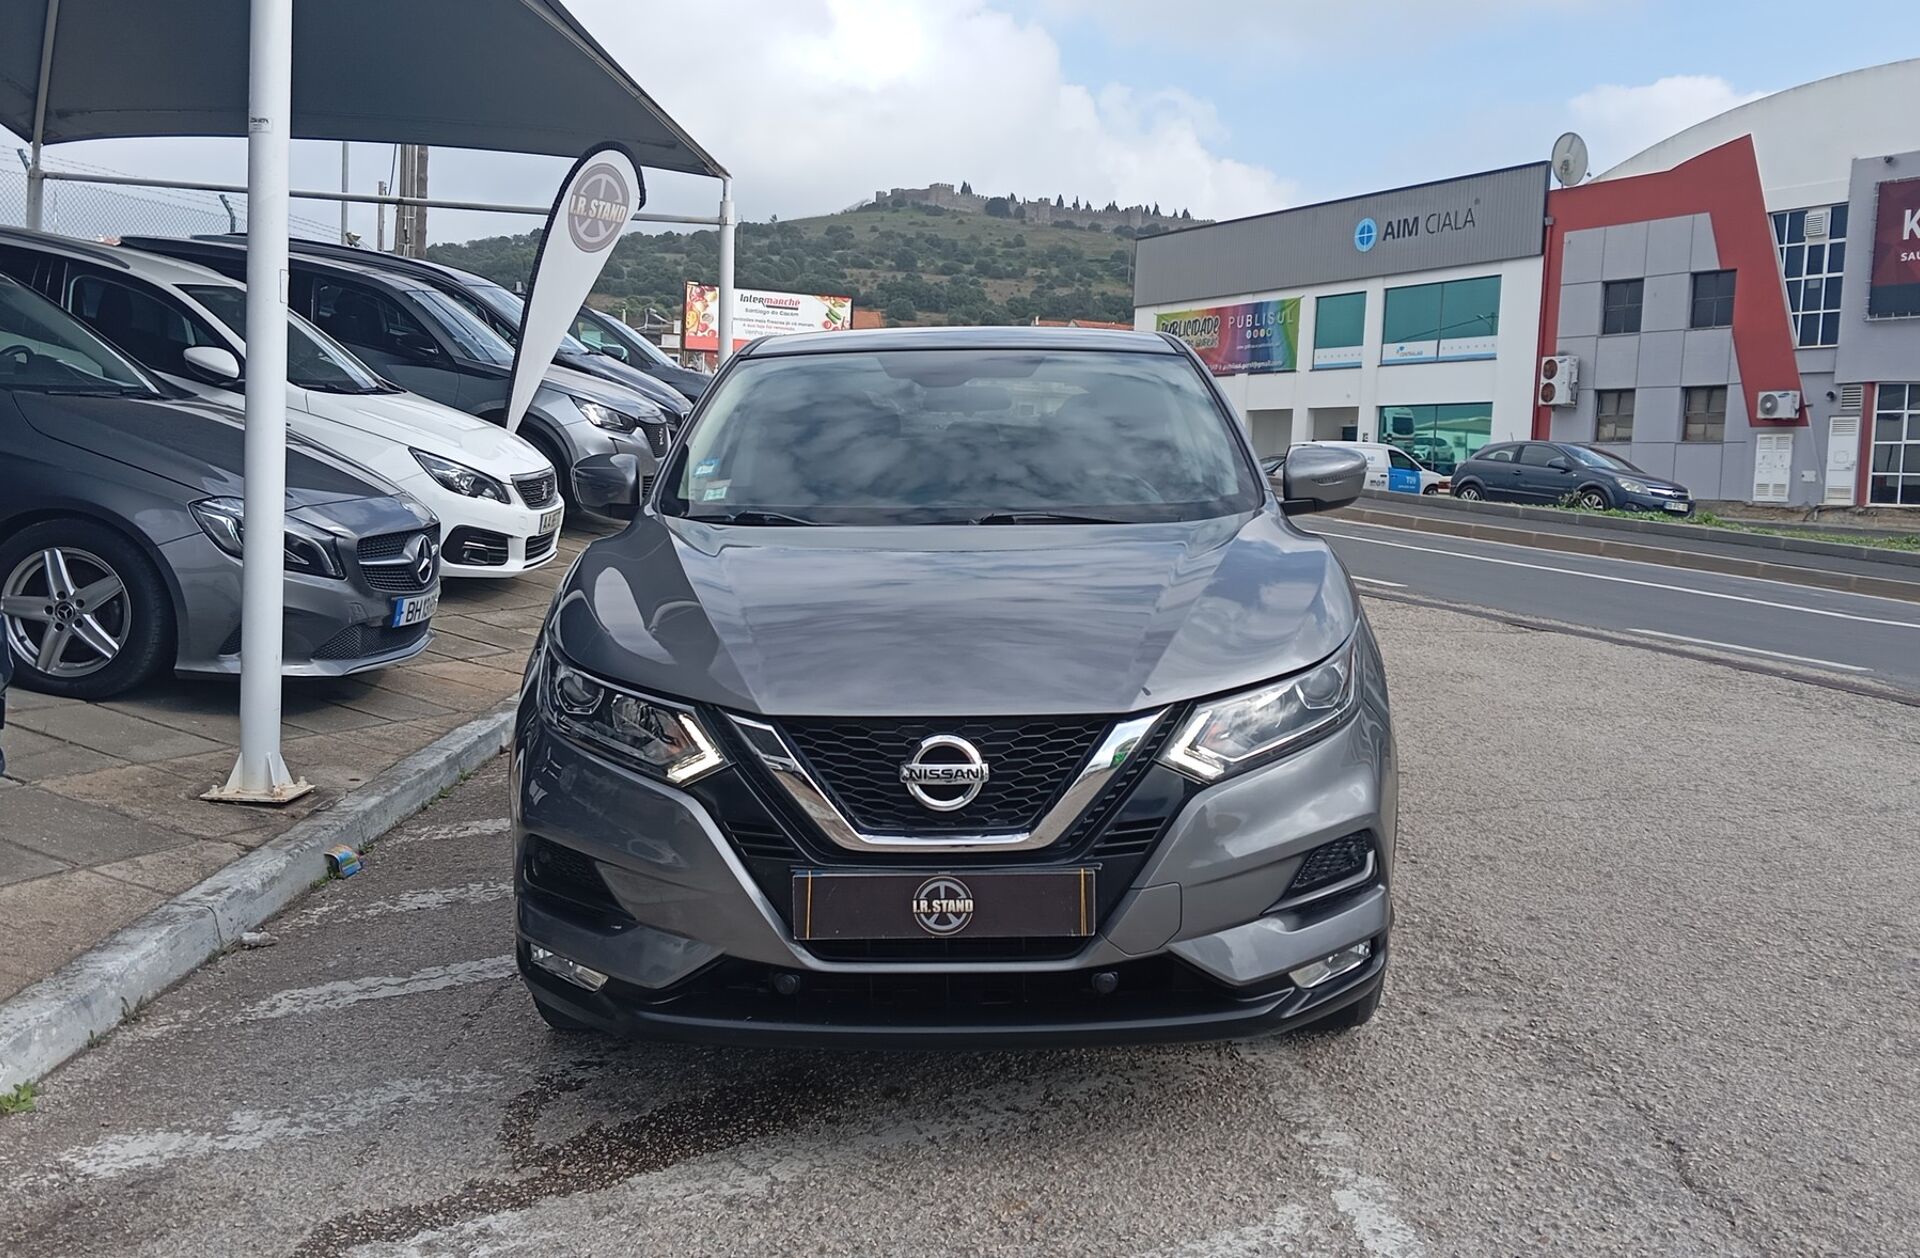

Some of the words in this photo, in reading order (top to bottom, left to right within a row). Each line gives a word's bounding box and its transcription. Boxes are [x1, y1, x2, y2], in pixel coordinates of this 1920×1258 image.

[589, 198, 627, 223] STAND
[1382, 216, 1419, 241] AIM
[1228, 310, 1294, 329] PUBLISUL
[909, 768, 979, 780] NISSAN
[913, 899, 931, 913] I.R.
[932, 899, 974, 913] STAND
